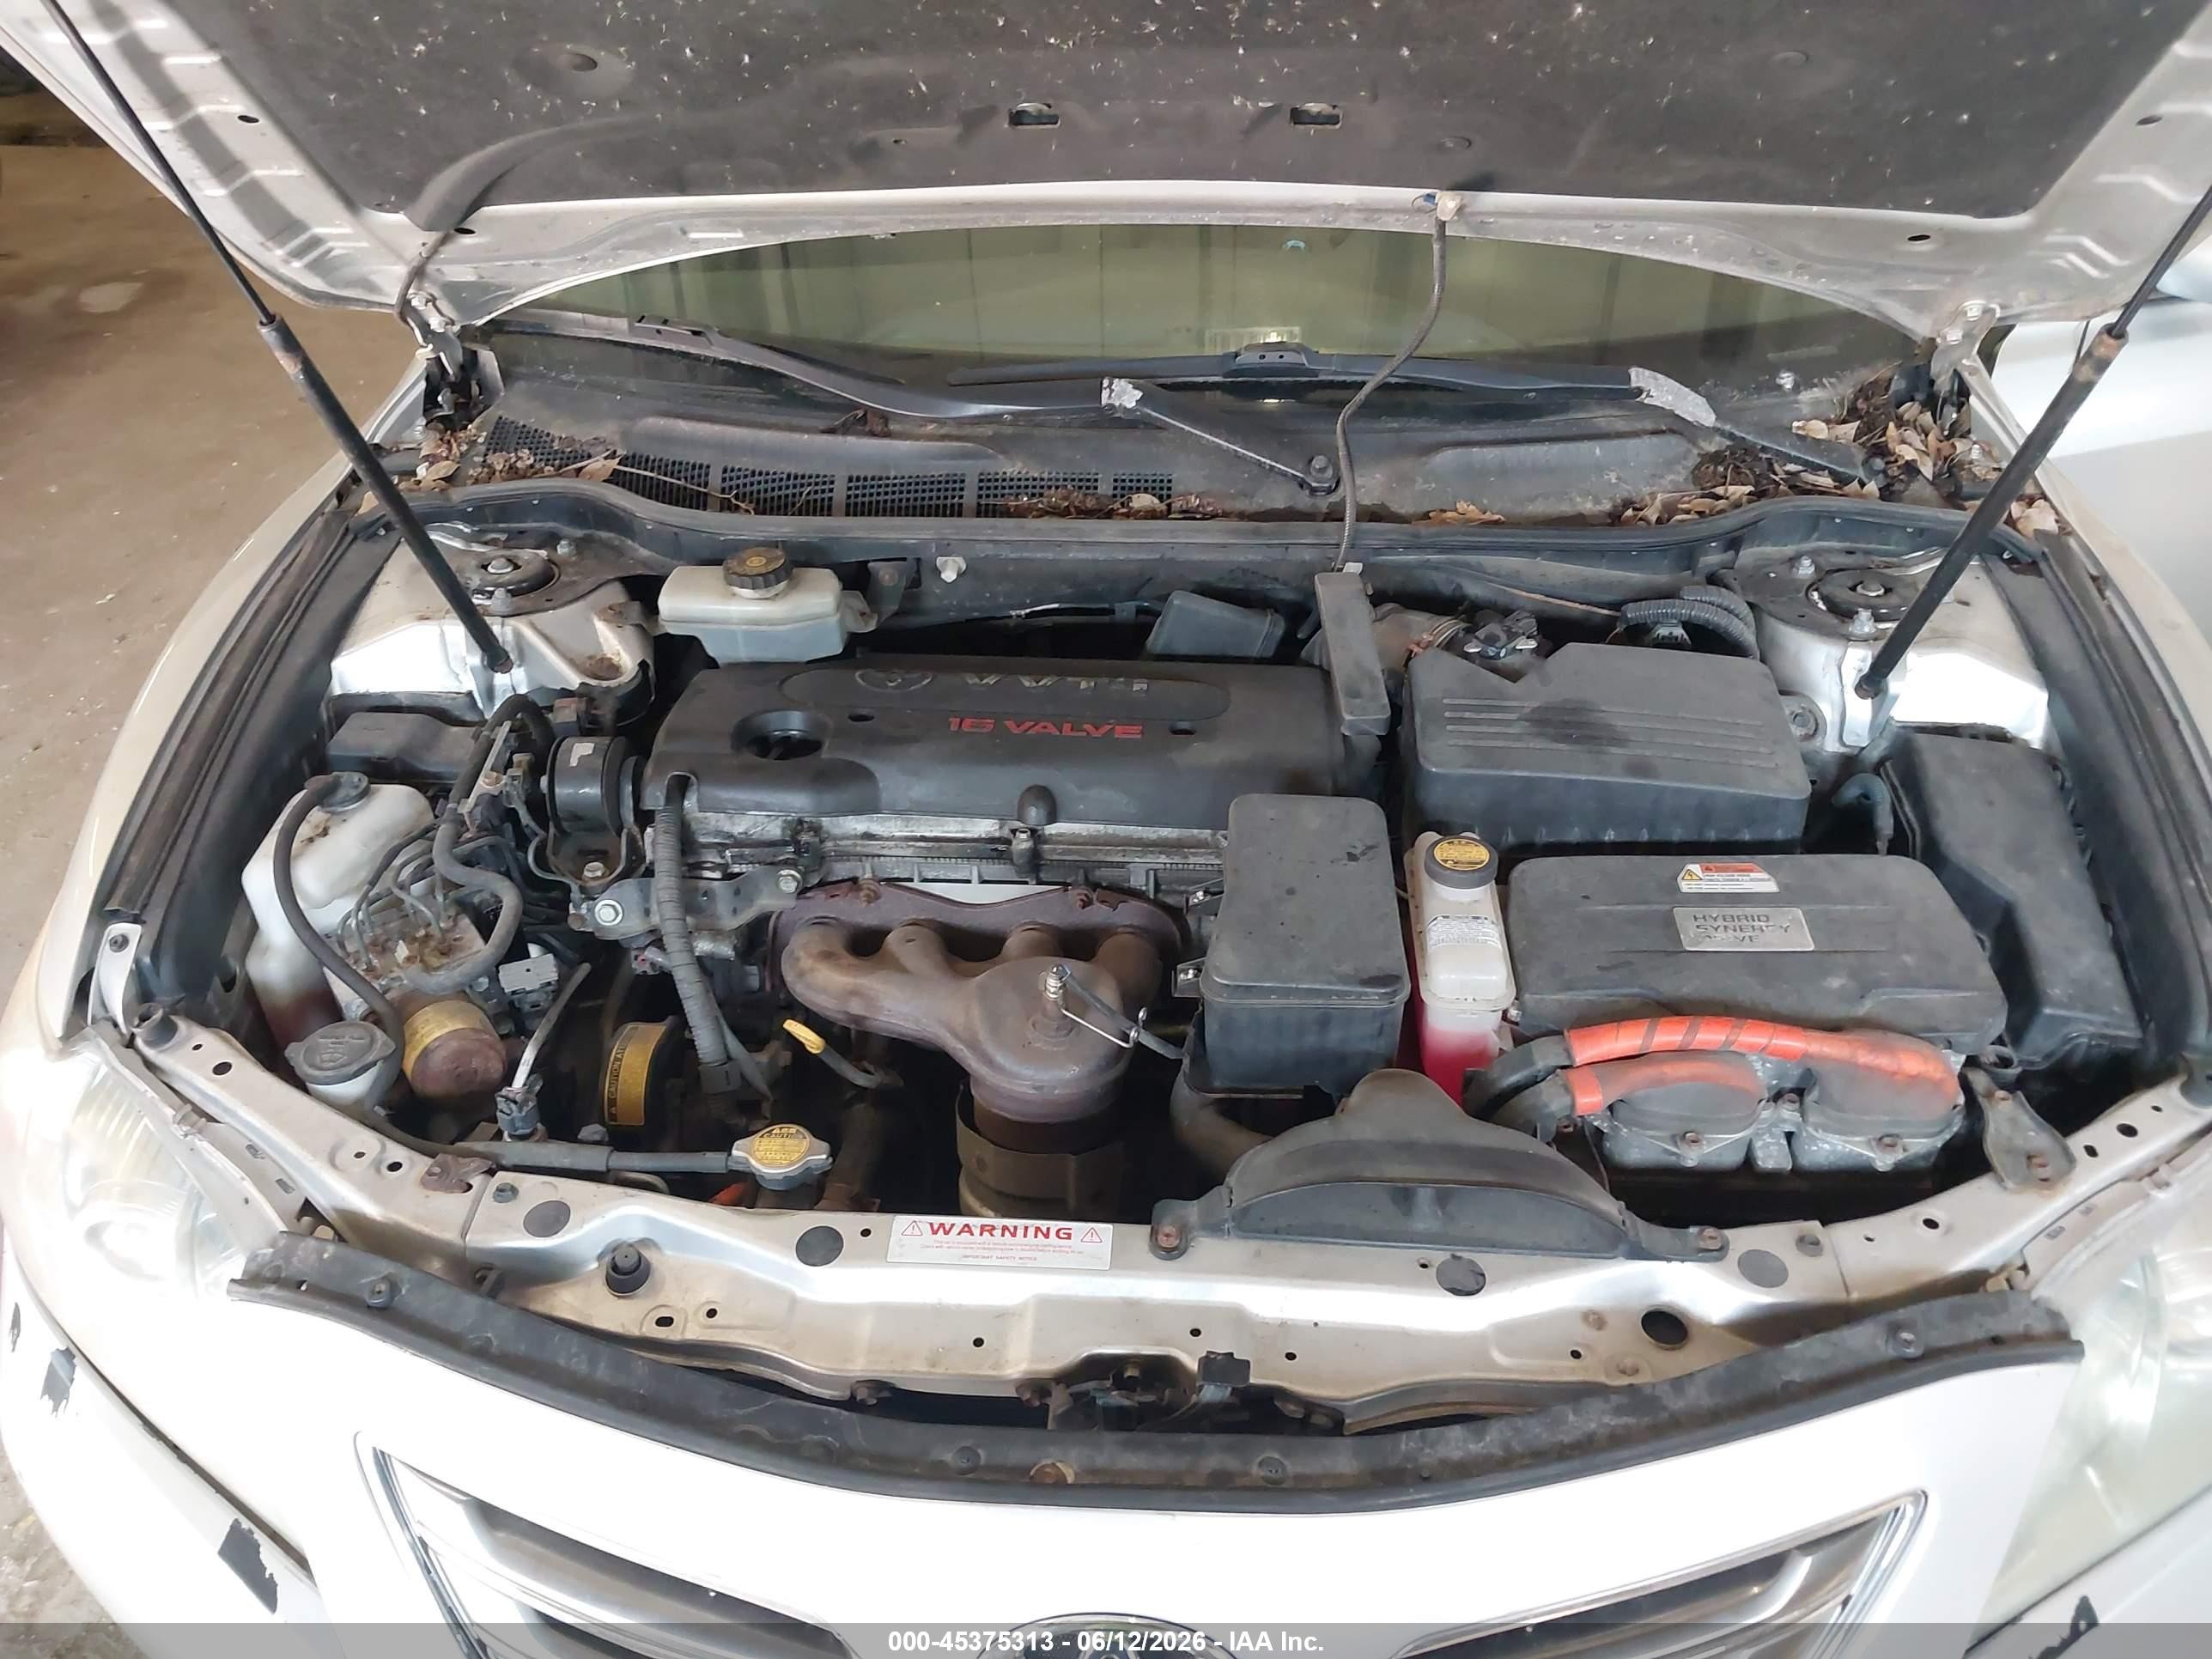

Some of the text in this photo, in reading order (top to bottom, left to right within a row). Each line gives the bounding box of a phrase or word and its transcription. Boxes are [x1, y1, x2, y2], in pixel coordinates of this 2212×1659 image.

[948, 716, 1145, 739] 16 VALVE
[1692, 914, 1770, 923] HYBRID
[927, 1221, 1073, 1240] WARNING
